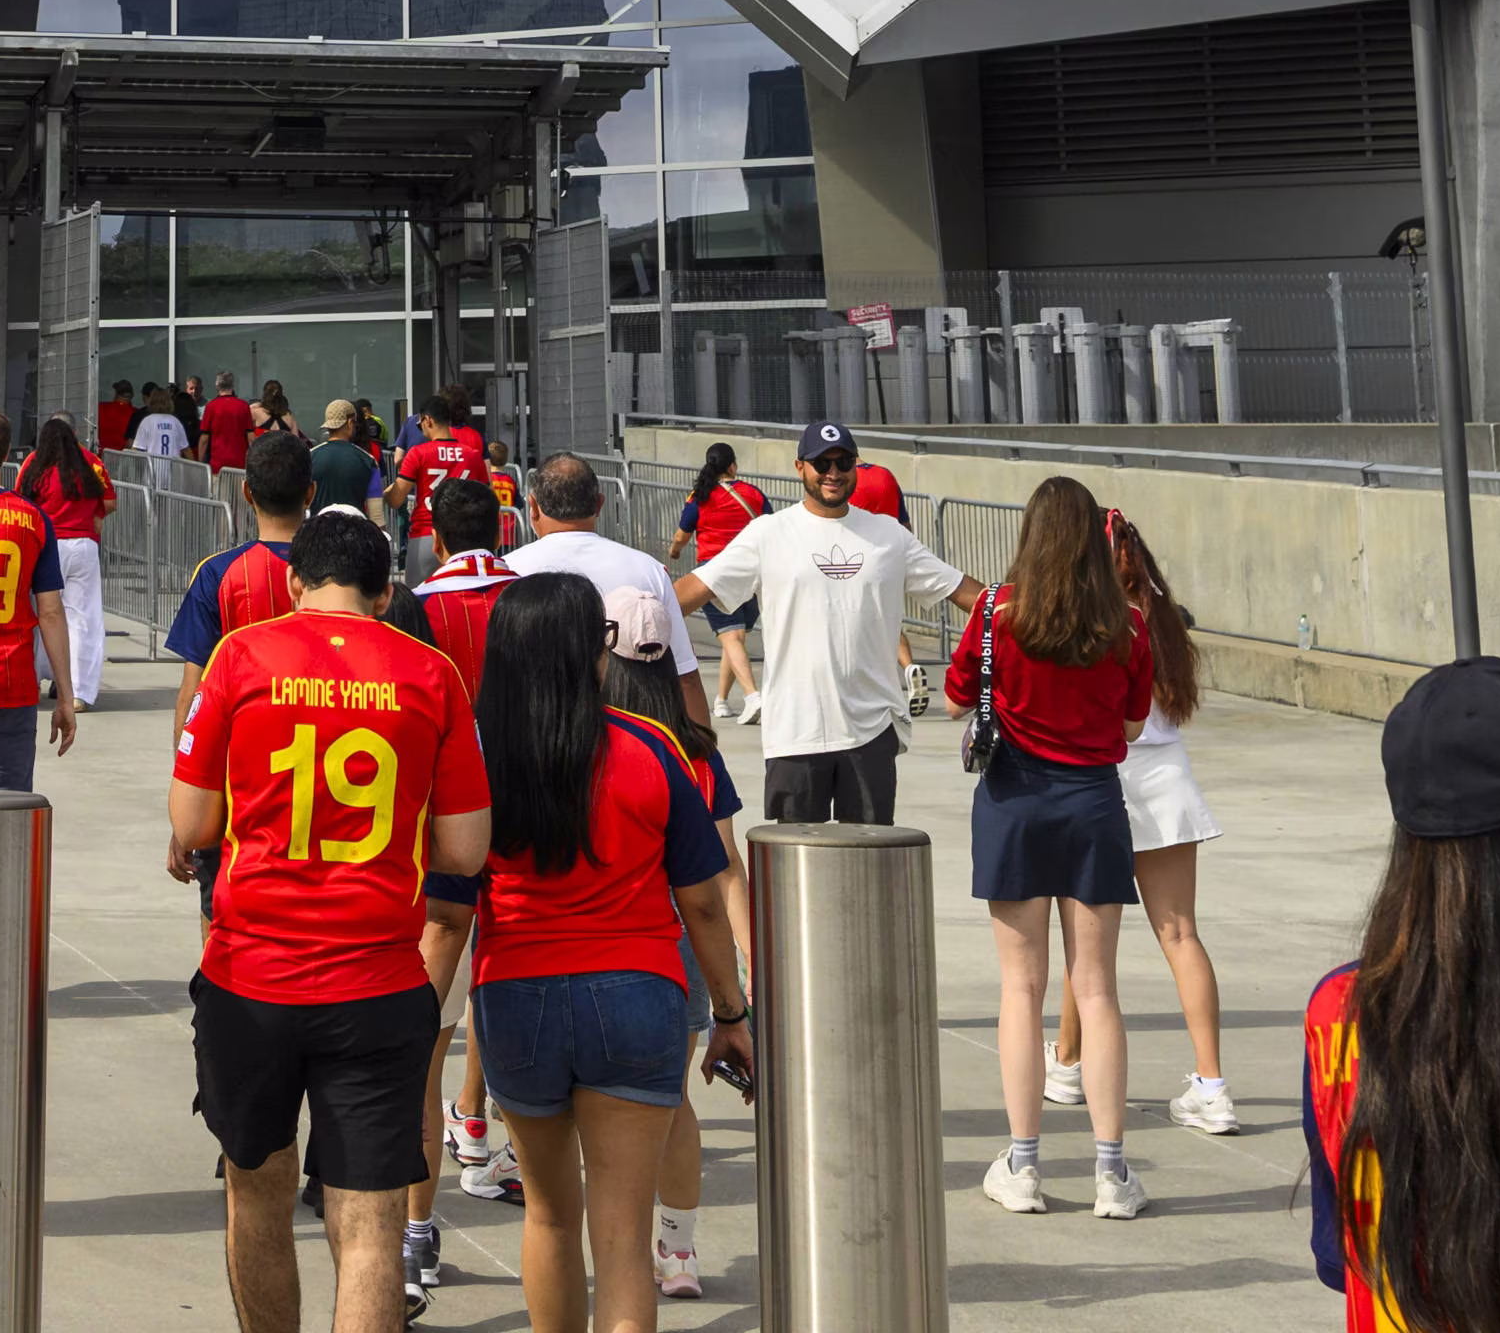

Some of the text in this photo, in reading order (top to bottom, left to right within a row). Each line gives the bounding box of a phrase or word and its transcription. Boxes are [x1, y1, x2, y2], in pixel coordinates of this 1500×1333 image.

[438, 447, 464, 461] DEE
[271, 676, 401, 712] LAMINE YAMAL
[270, 723, 398, 864] 19
